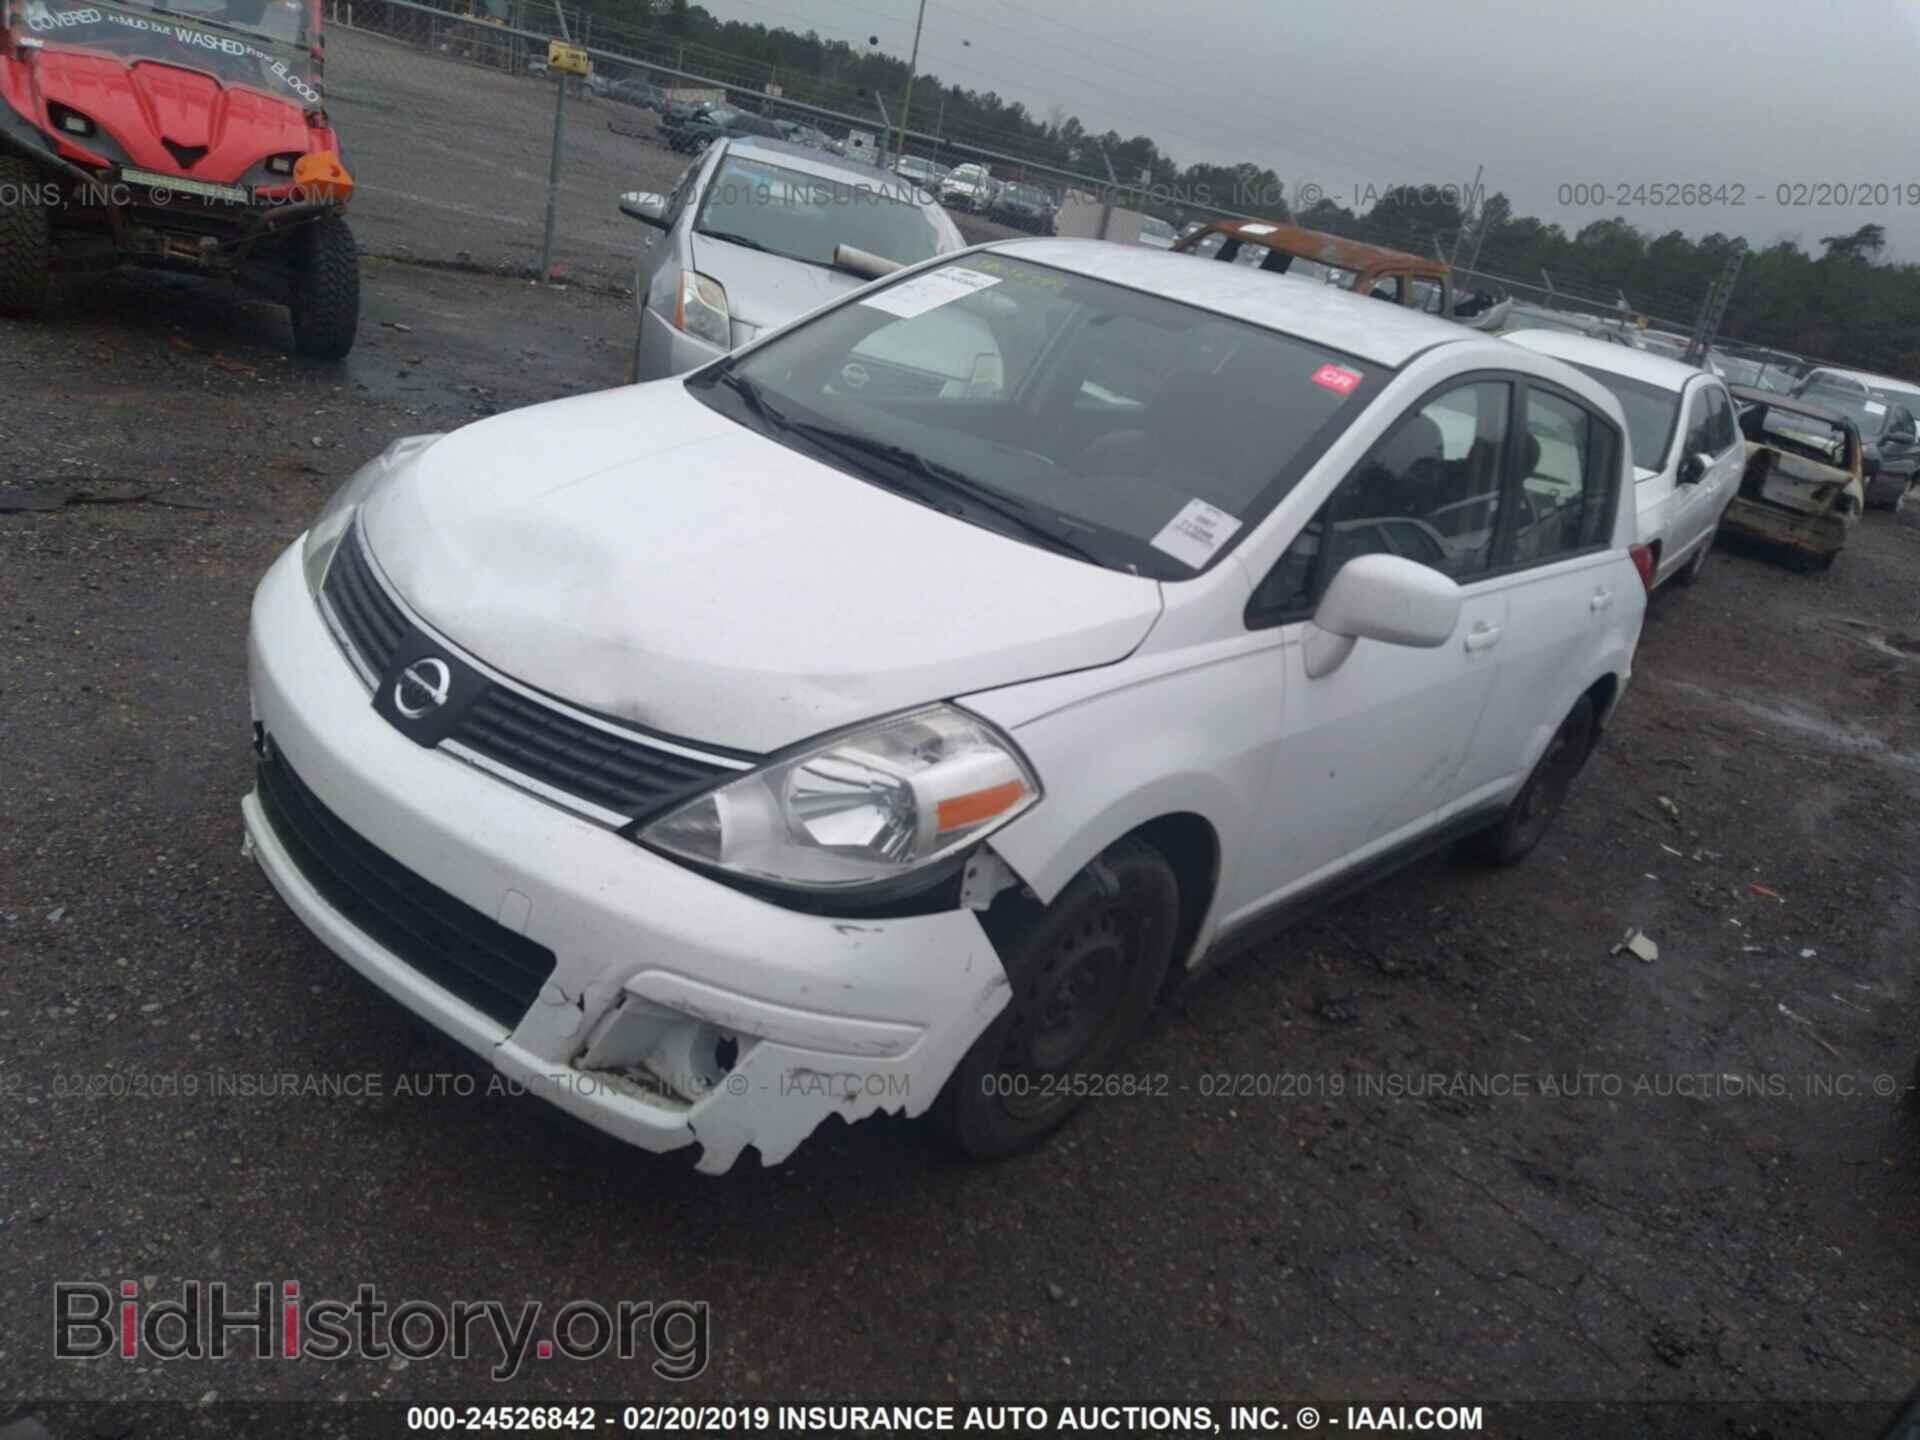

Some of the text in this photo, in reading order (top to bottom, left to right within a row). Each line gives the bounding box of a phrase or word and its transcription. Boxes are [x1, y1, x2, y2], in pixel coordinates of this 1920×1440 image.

[28, 8, 102, 31] COVERED
[174, 27, 244, 55] WASHED
[270, 62, 319, 102] BLOOD
